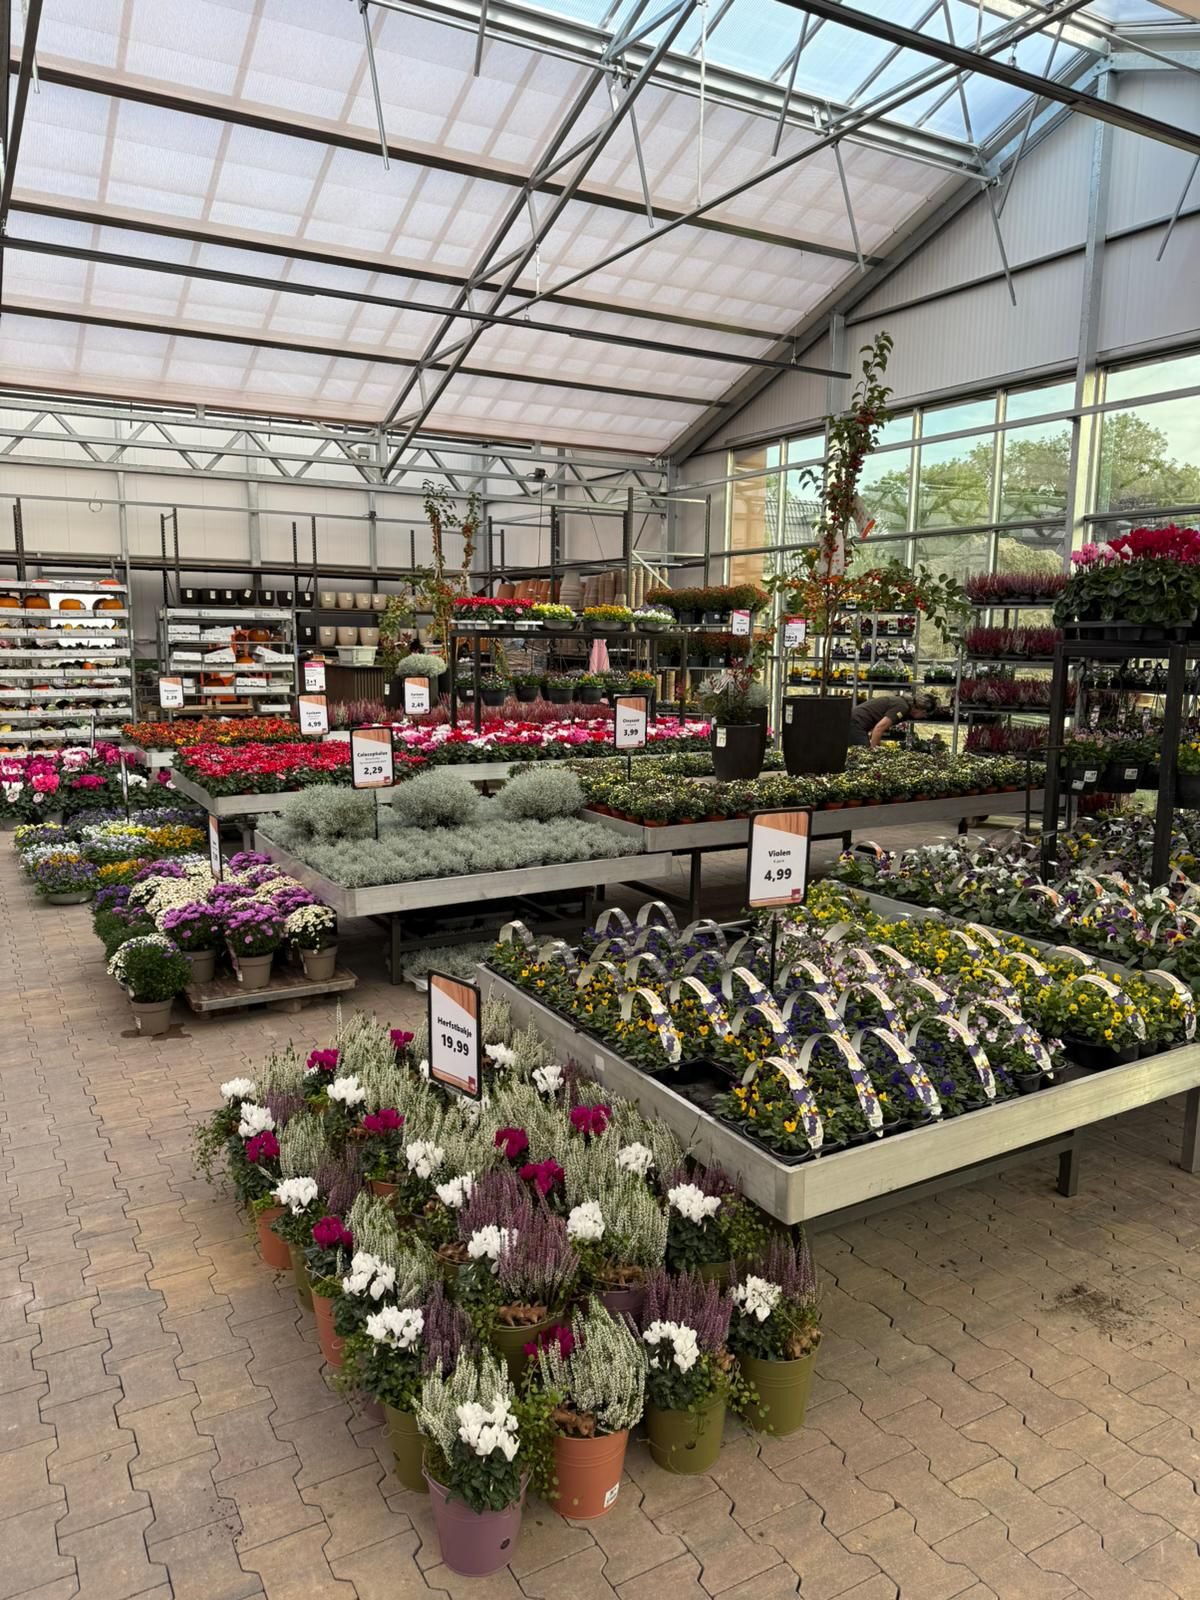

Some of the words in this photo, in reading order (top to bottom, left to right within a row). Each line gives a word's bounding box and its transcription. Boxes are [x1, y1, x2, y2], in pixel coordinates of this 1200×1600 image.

[307, 720, 322, 728] 4,99
[623, 728, 639, 737] 3,99
[363, 766, 383, 775] 2,29
[768, 849, 791, 858] Violen
[764, 868, 792, 882] 4,99
[437, 1016, 472, 1038] Herfstbakje
[441, 1034, 469, 1056] 19,99
